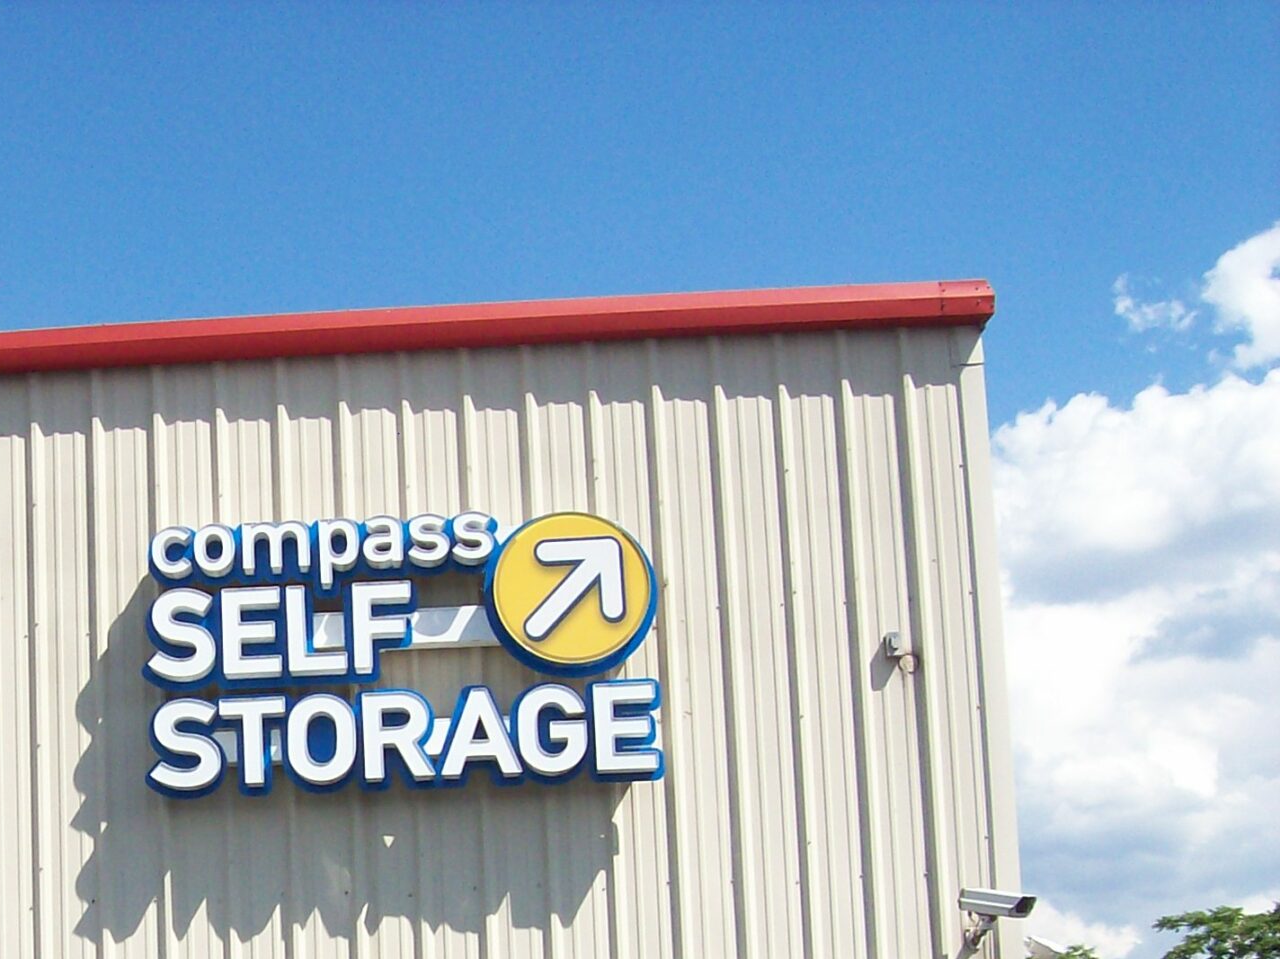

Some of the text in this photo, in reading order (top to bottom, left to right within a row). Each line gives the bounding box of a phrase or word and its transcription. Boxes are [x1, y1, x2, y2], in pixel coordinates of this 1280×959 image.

[149, 510, 498, 590] compass
[144, 580, 416, 684] SELF
[147, 679, 663, 793] STORAGE
